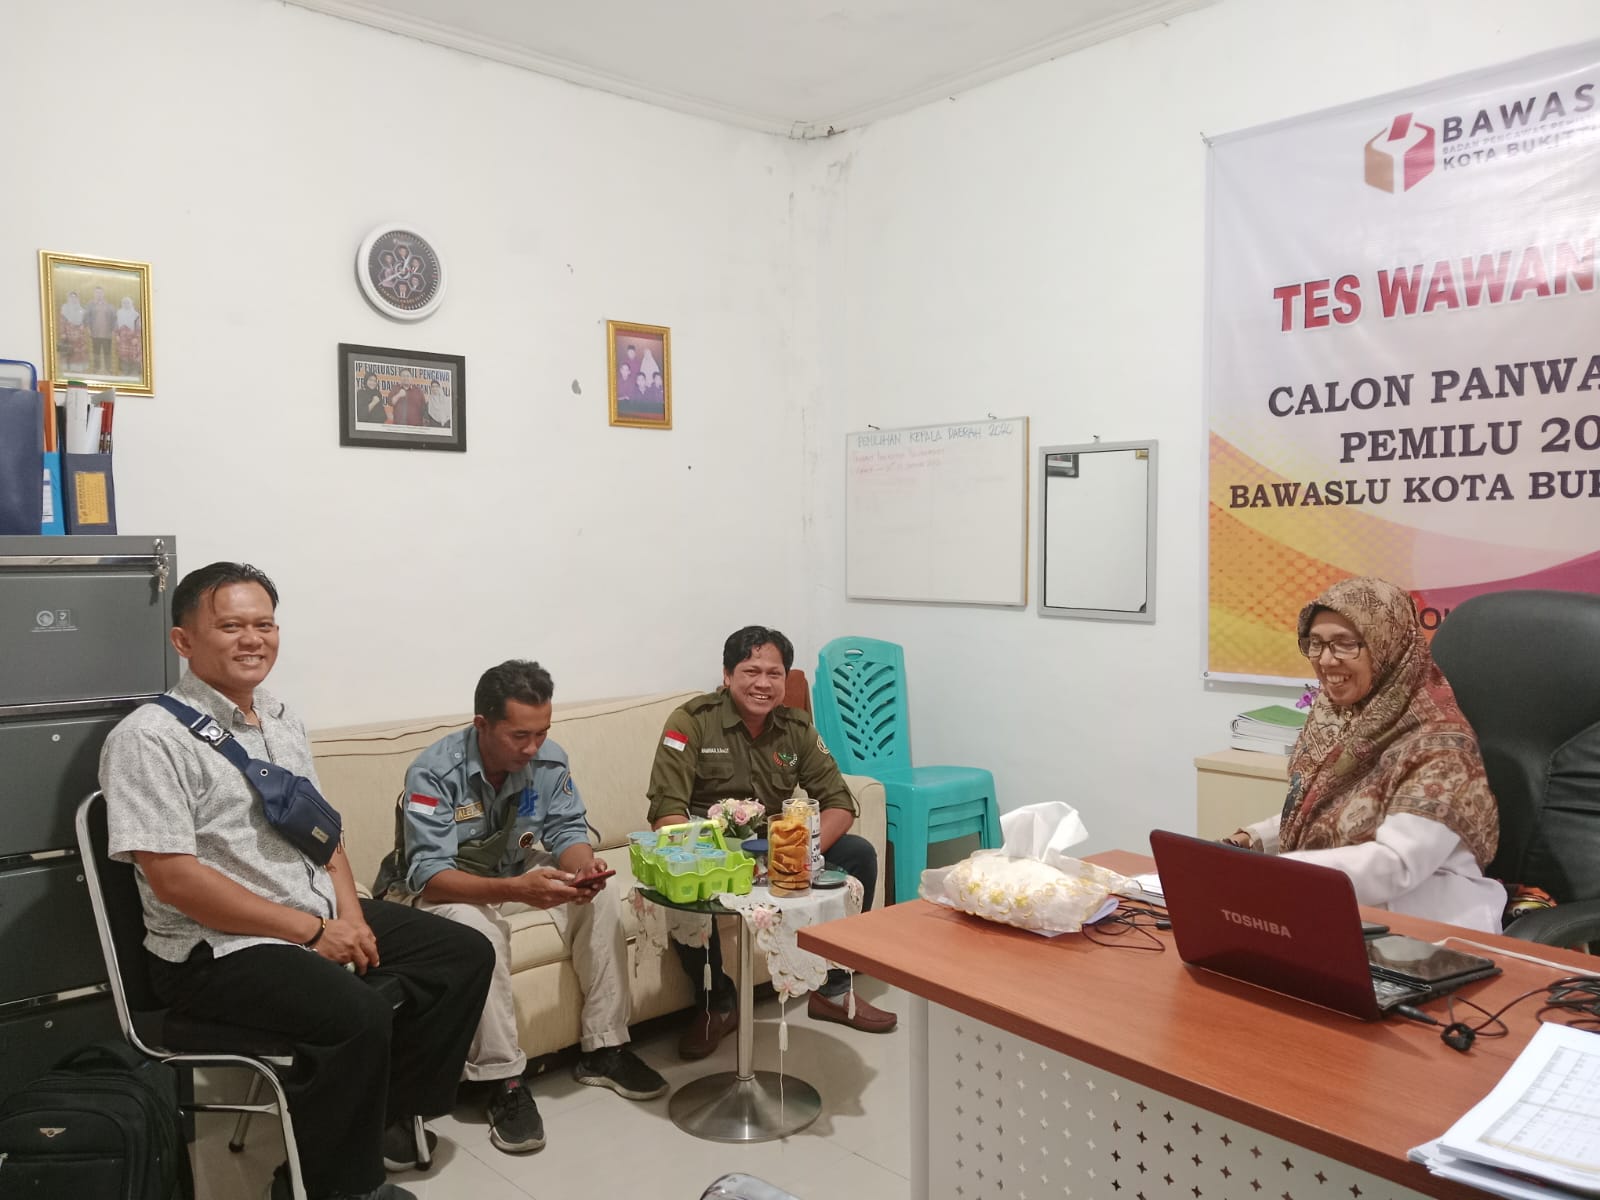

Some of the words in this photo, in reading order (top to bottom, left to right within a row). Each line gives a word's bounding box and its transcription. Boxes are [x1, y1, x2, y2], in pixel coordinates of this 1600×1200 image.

[1443, 83, 1595, 144] BAWAS
[1443, 147, 1497, 170] KOTA
[1273, 274, 1361, 333] TES
[1376, 238, 1594, 318] WAWAN
[1268, 373, 1414, 417] CALON
[1430, 354, 1600, 404] PANWA
[909, 429, 943, 444] KEPALA
[948, 425, 981, 441] DAERAH
[1340, 420, 1522, 463] PEMILU
[1541, 414, 1600, 453] 20
[1229, 478, 1391, 509] BAWASLU
[1403, 474, 1514, 503] KOTA
[1221, 909, 1292, 938] TOSHIBA
